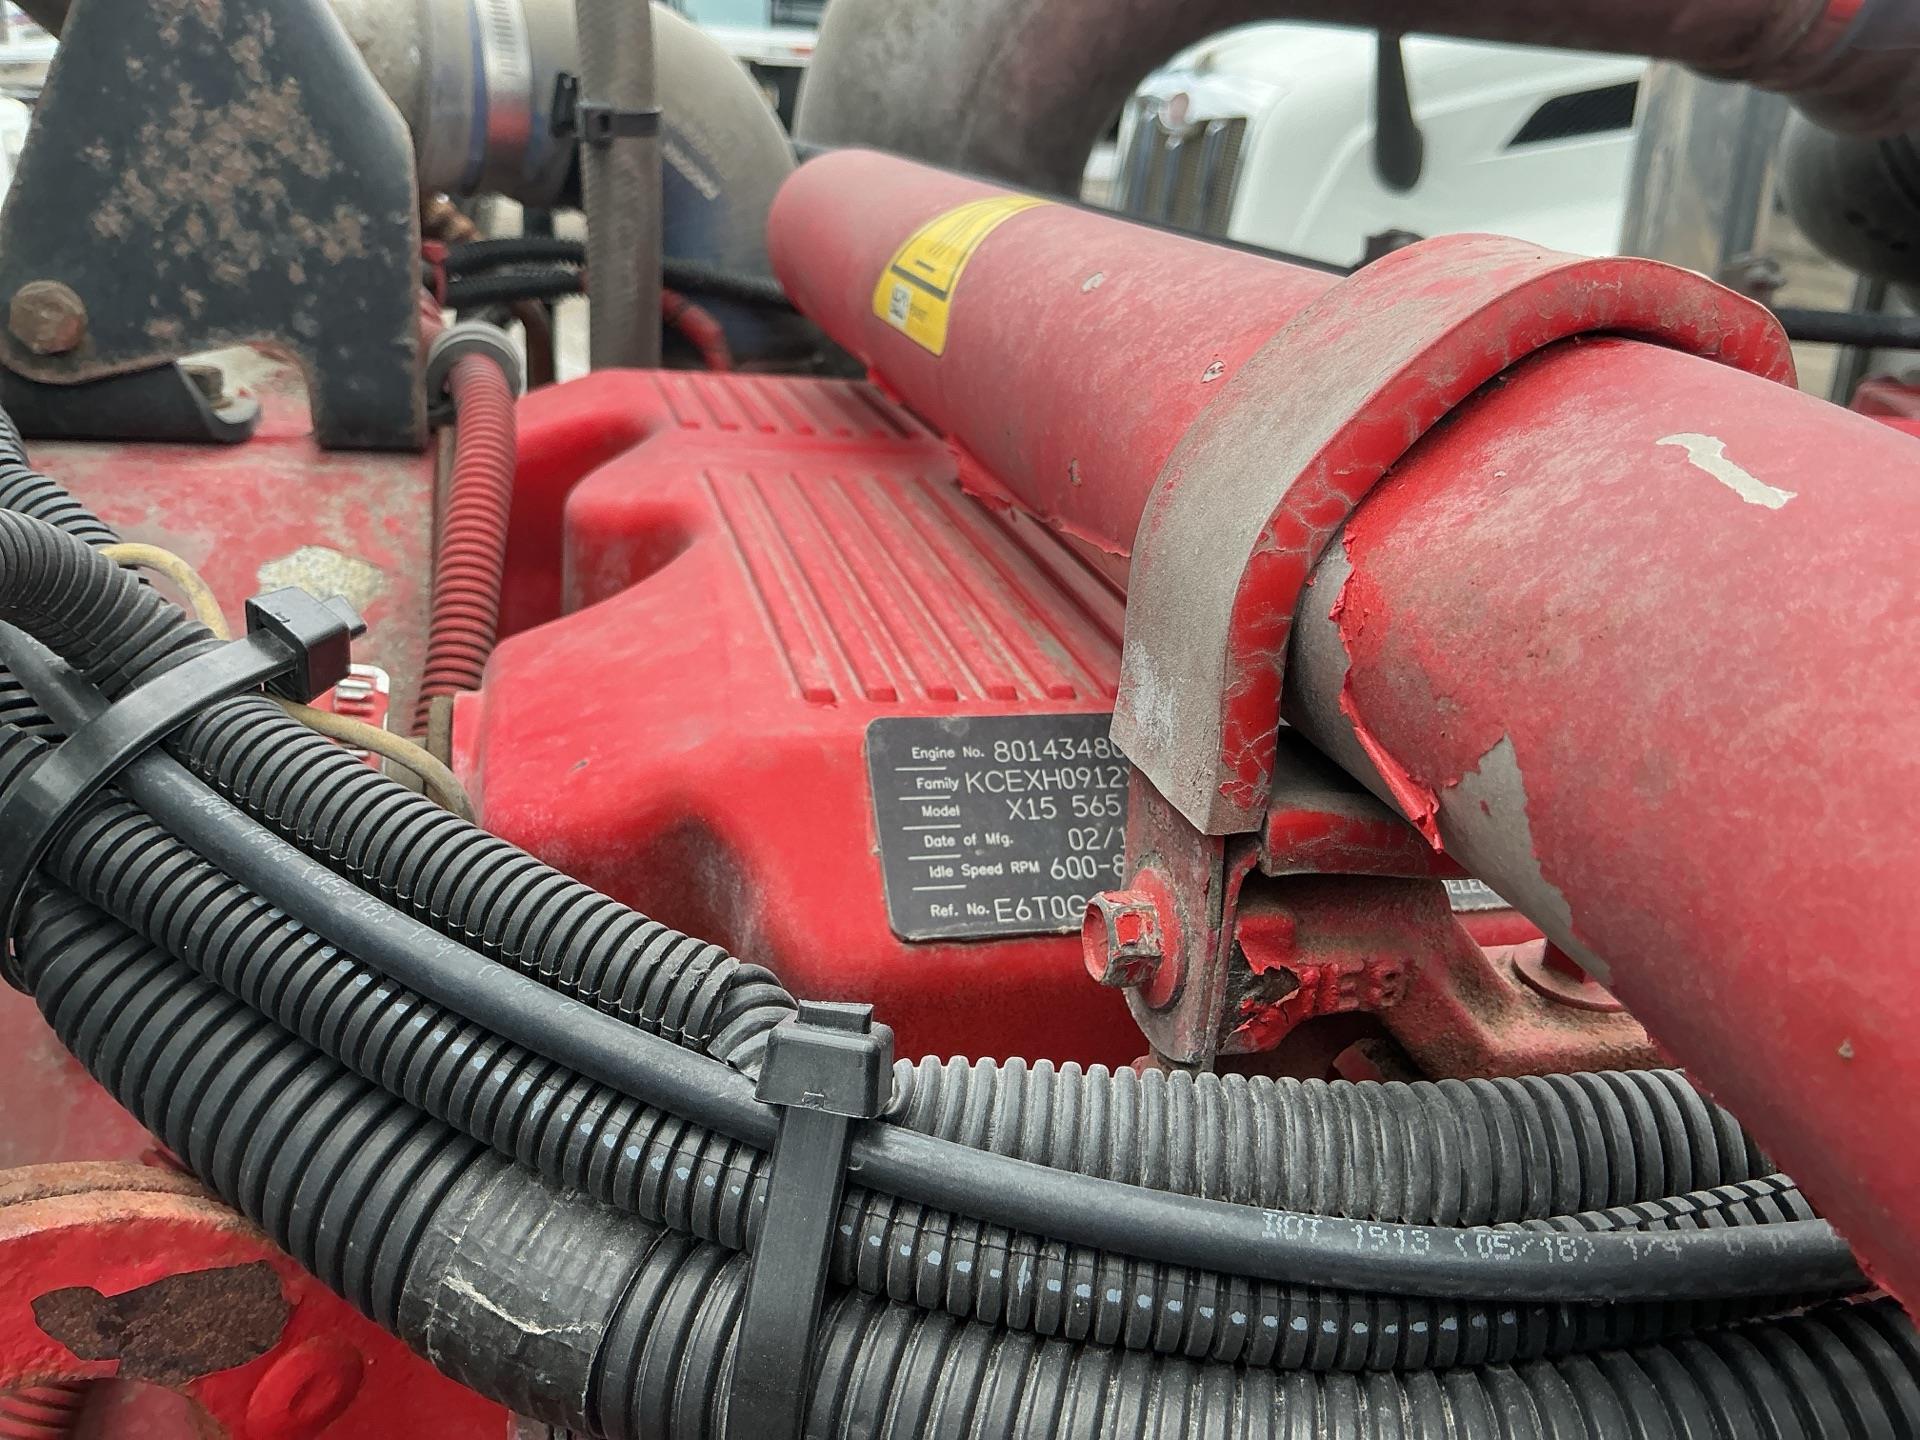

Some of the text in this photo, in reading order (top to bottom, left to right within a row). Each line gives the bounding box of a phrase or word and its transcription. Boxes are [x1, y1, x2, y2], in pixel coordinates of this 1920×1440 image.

[912, 746, 956, 761] Engine
[963, 746, 985, 759] No.
[916, 777, 960, 792] Family
[921, 793, 1121, 820] Model X15 565
[924, 834, 955, 848] Date
[963, 834, 978, 846] of
[985, 833, 1014, 847] Mfg.
[929, 866, 954, 878] Idle
[961, 863, 1003, 879] Speed
[1010, 861, 1040, 874] RPM
[930, 904, 958, 918] Ref.
[967, 903, 991, 915] No.
